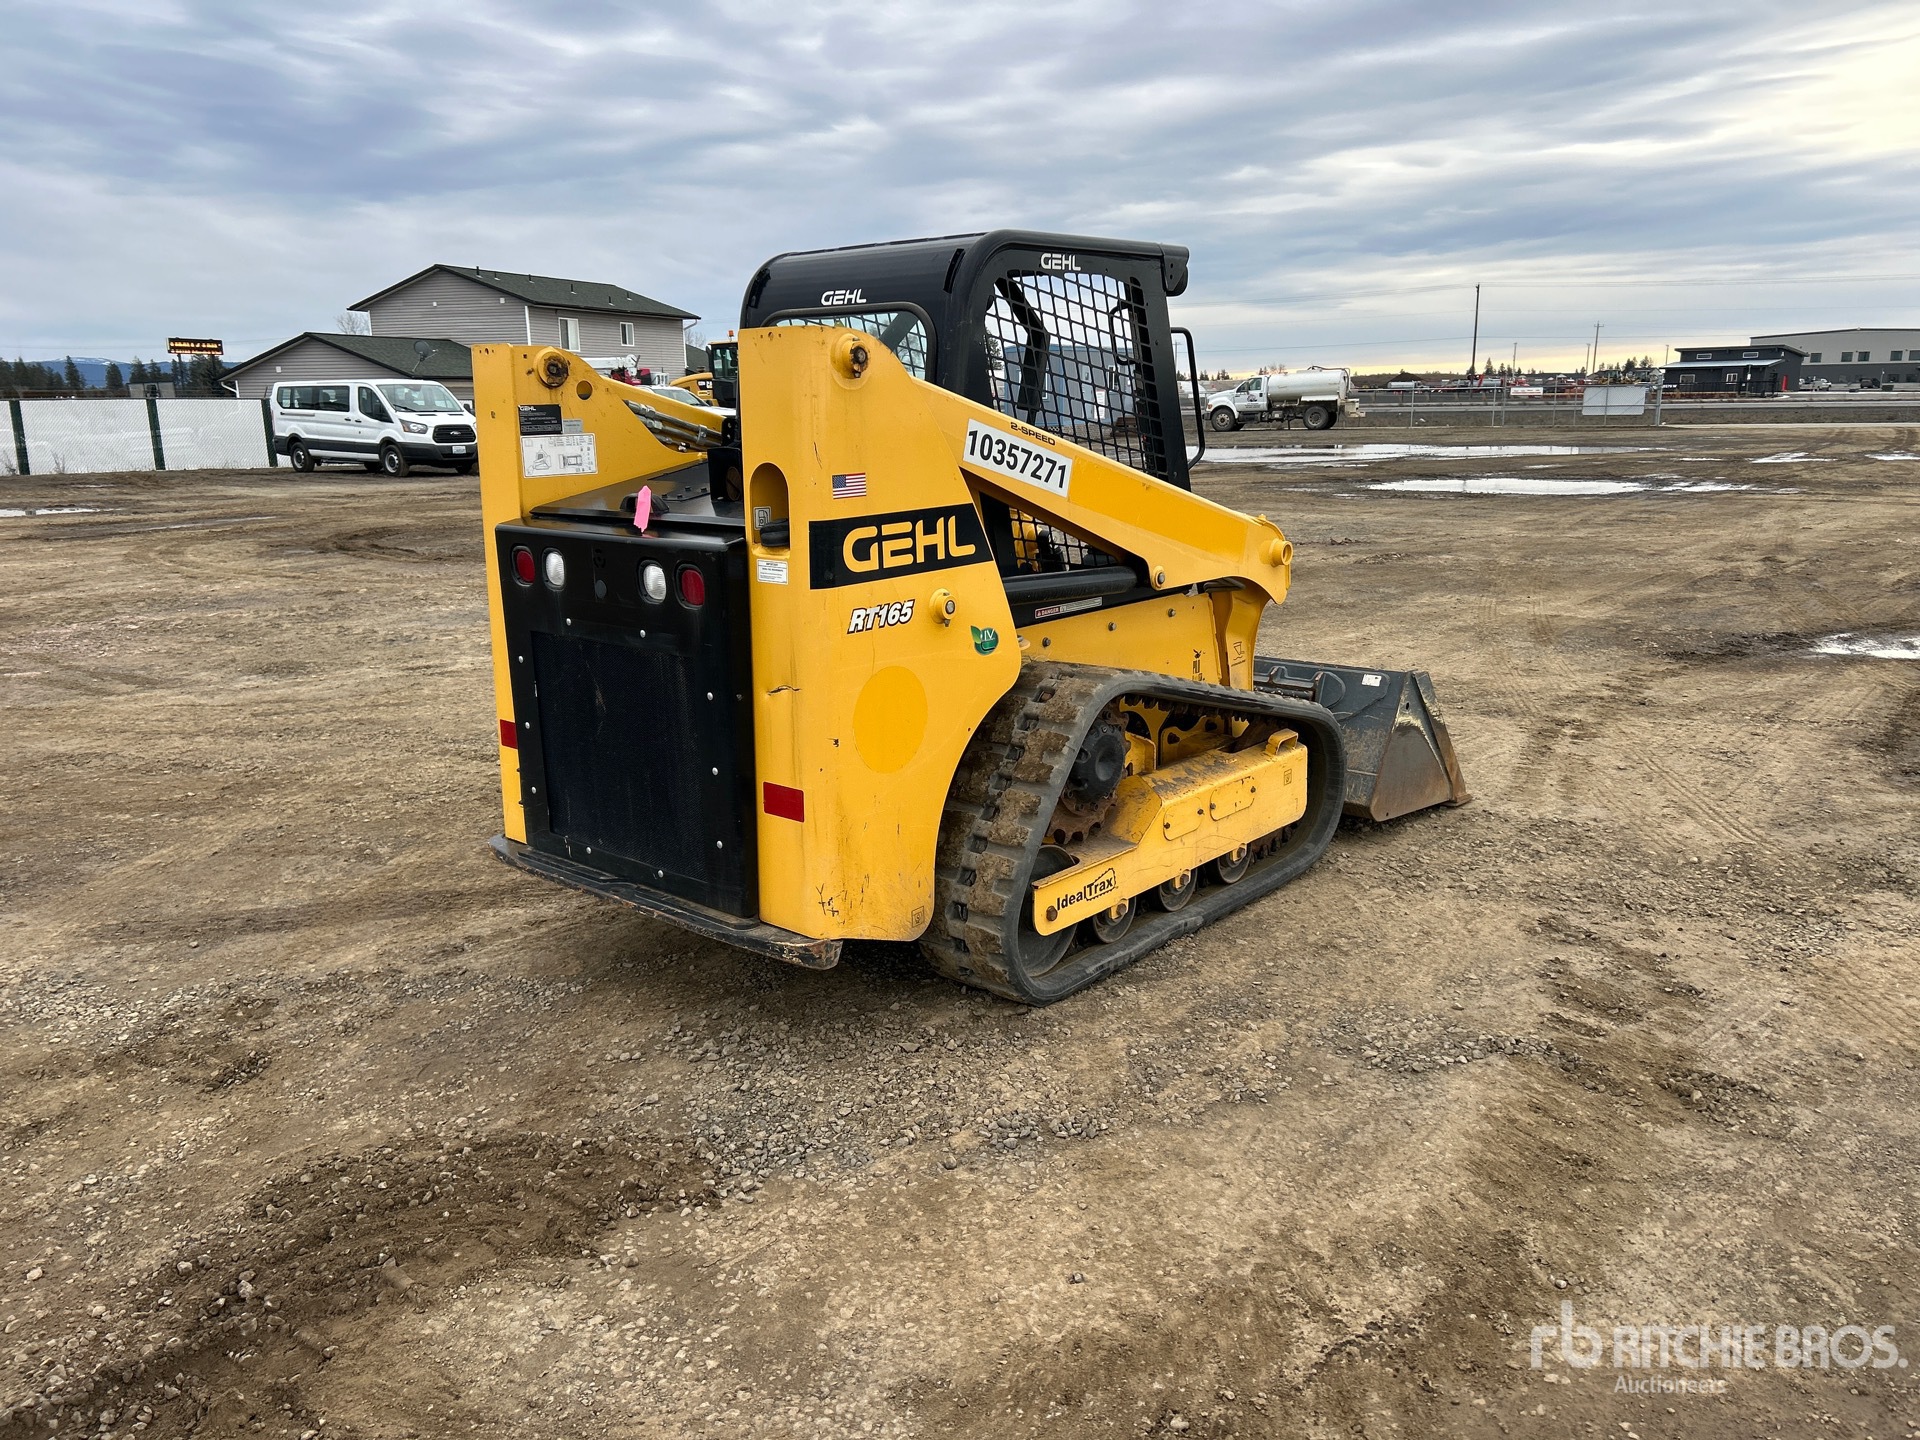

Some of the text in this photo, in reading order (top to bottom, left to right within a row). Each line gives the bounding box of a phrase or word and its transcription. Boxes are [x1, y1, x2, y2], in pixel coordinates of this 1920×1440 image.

[1040, 252, 1082, 271] GEHL
[820, 288, 867, 306] GEHL
[1010, 421, 1056, 446] 2-SPEED
[968, 430, 1067, 489] 10357271
[842, 515, 976, 573] GEHL
[847, 599, 915, 634] RT165
[1056, 876, 1114, 911] IdealTrax
